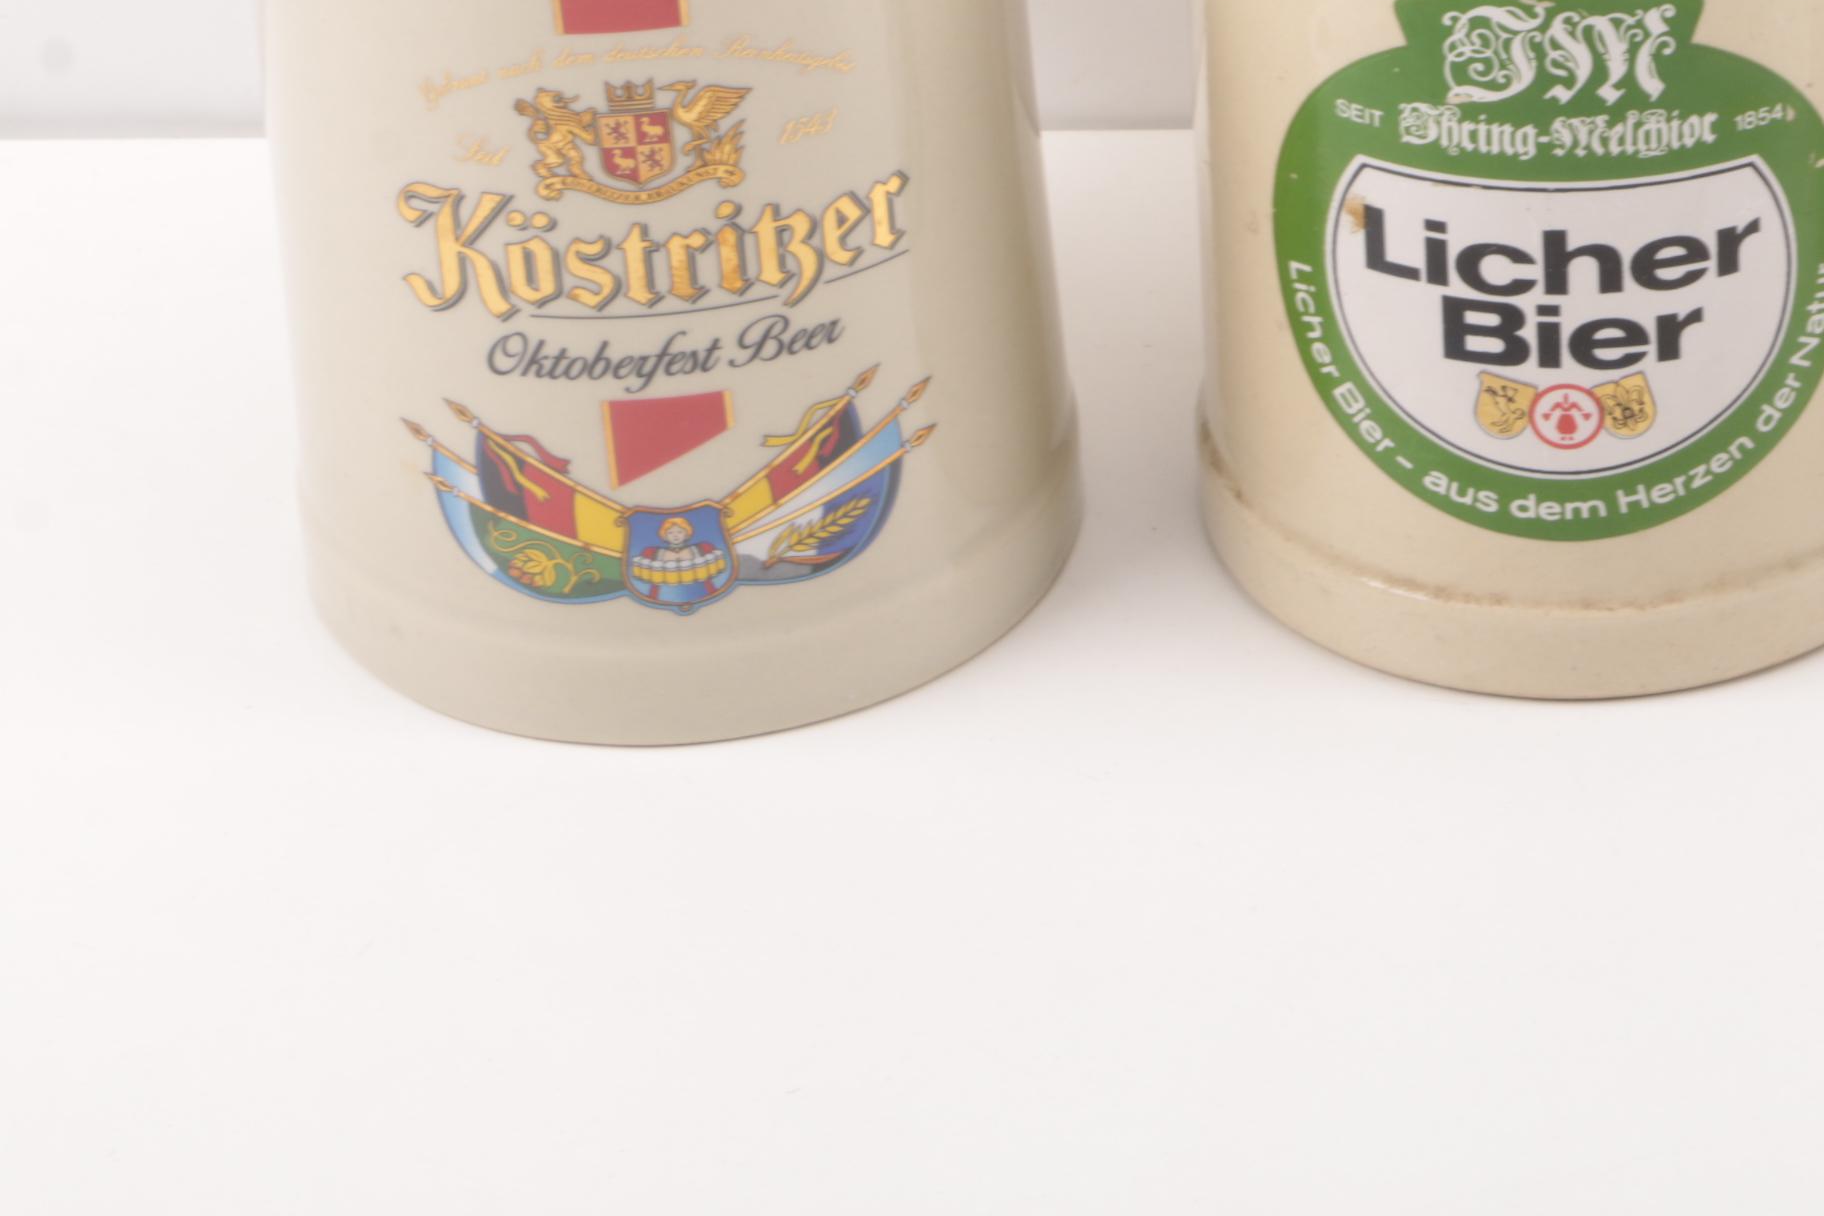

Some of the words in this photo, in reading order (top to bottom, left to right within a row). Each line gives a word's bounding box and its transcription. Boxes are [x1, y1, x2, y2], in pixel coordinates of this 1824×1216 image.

[551, 45, 597, 69] dem
[1334, 99, 1384, 127] SEIT
[1733, 103, 1785, 131] 1854
[396, 169, 910, 321] Köstritzer
[1362, 202, 1762, 298] Licher
[486, 331, 721, 394] Oktoberfest
[727, 313, 846, 367] Beer
[1441, 294, 1705, 371] Bier
[1287, 259, 1340, 379] Licher
[1332, 380, 1397, 454] Bier
[1422, 469, 1499, 514] aus
[1509, 492, 1607, 522] dem
[1616, 435, 1755, 516] Herzen
[1756, 371, 1803, 434] der
